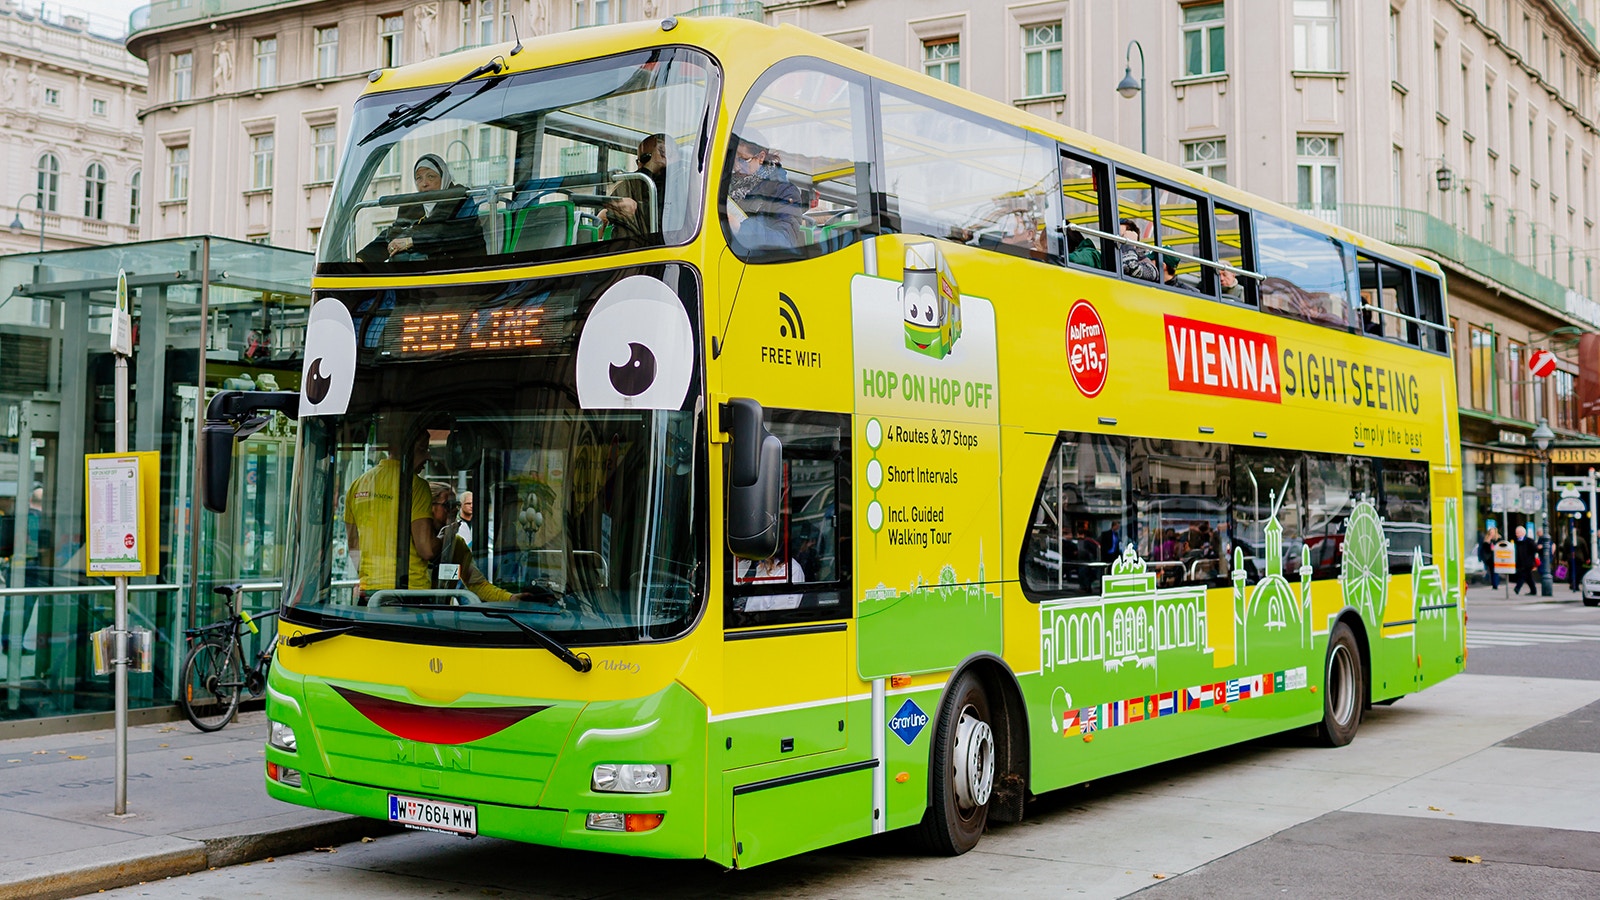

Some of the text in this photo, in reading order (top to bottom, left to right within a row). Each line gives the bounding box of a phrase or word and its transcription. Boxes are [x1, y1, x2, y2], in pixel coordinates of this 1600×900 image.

[402, 309, 544, 352] RED LINE
[1070, 322, 1101, 341] Ab/From
[761, 346, 822, 369] FREE WIFI
[1071, 342, 1106, 374] €15,-
[1168, 324, 1420, 415] VIENNA SIGHTSEEING
[862, 368, 993, 410] HOP ON HOP OFF
[887, 425, 979, 451] 4 Routes & 37 Stops
[1354, 422, 1423, 447] simply the best
[887, 465, 959, 484] Short Intervals
[888, 505, 945, 523] Incl. Guided
[887, 528, 953, 549] Walking Tour
[398, 801, 407, 818] W
[417, 803, 450, 825] 7664
[453, 809, 472, 829] MW
